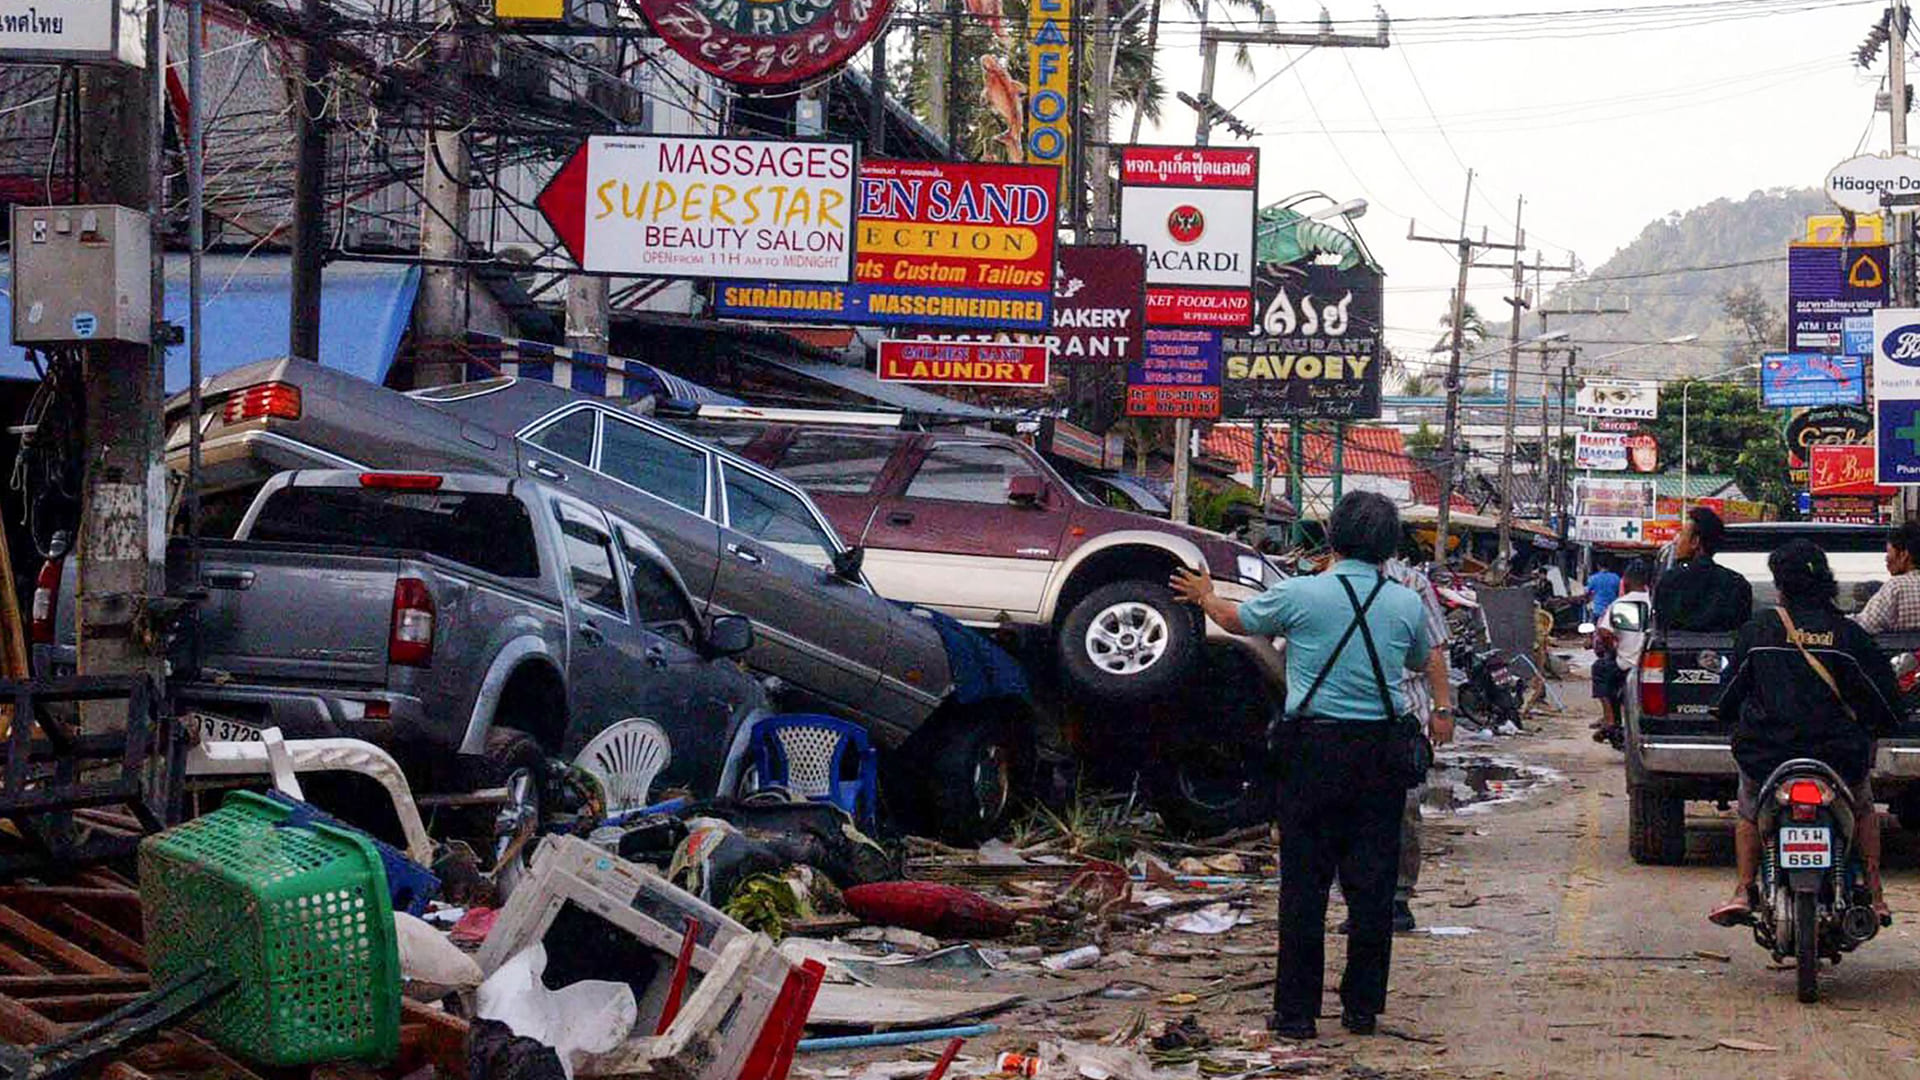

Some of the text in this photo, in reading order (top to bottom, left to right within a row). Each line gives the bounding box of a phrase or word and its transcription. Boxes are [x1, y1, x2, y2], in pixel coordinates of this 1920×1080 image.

[658, 142, 850, 179] MASSAGES
[594, 178, 845, 230] SUPERSTAR
[858, 177, 1050, 227] EN SAND
[645, 225, 845, 252] BEAUTY SALON
[866, 226, 1025, 252] ECTION
[643, 252, 673, 264] OPEN
[673, 254, 704, 265] FROM
[710, 252, 741, 265] 11H
[783, 254, 841, 268] MIDNIGHT
[893, 260, 967, 283] Custom
[977, 262, 1045, 287] Tailors
[868, 293, 1044, 321] MASSCHNEIDEREI
[1176, 295, 1249, 309] FOODLAND
[1796, 321, 1819, 331] ATM
[888, 359, 1034, 381] LAUNDRY
[1227, 355, 1371, 380] SAVOEY
[1612, 407, 1655, 417] OPTIC
